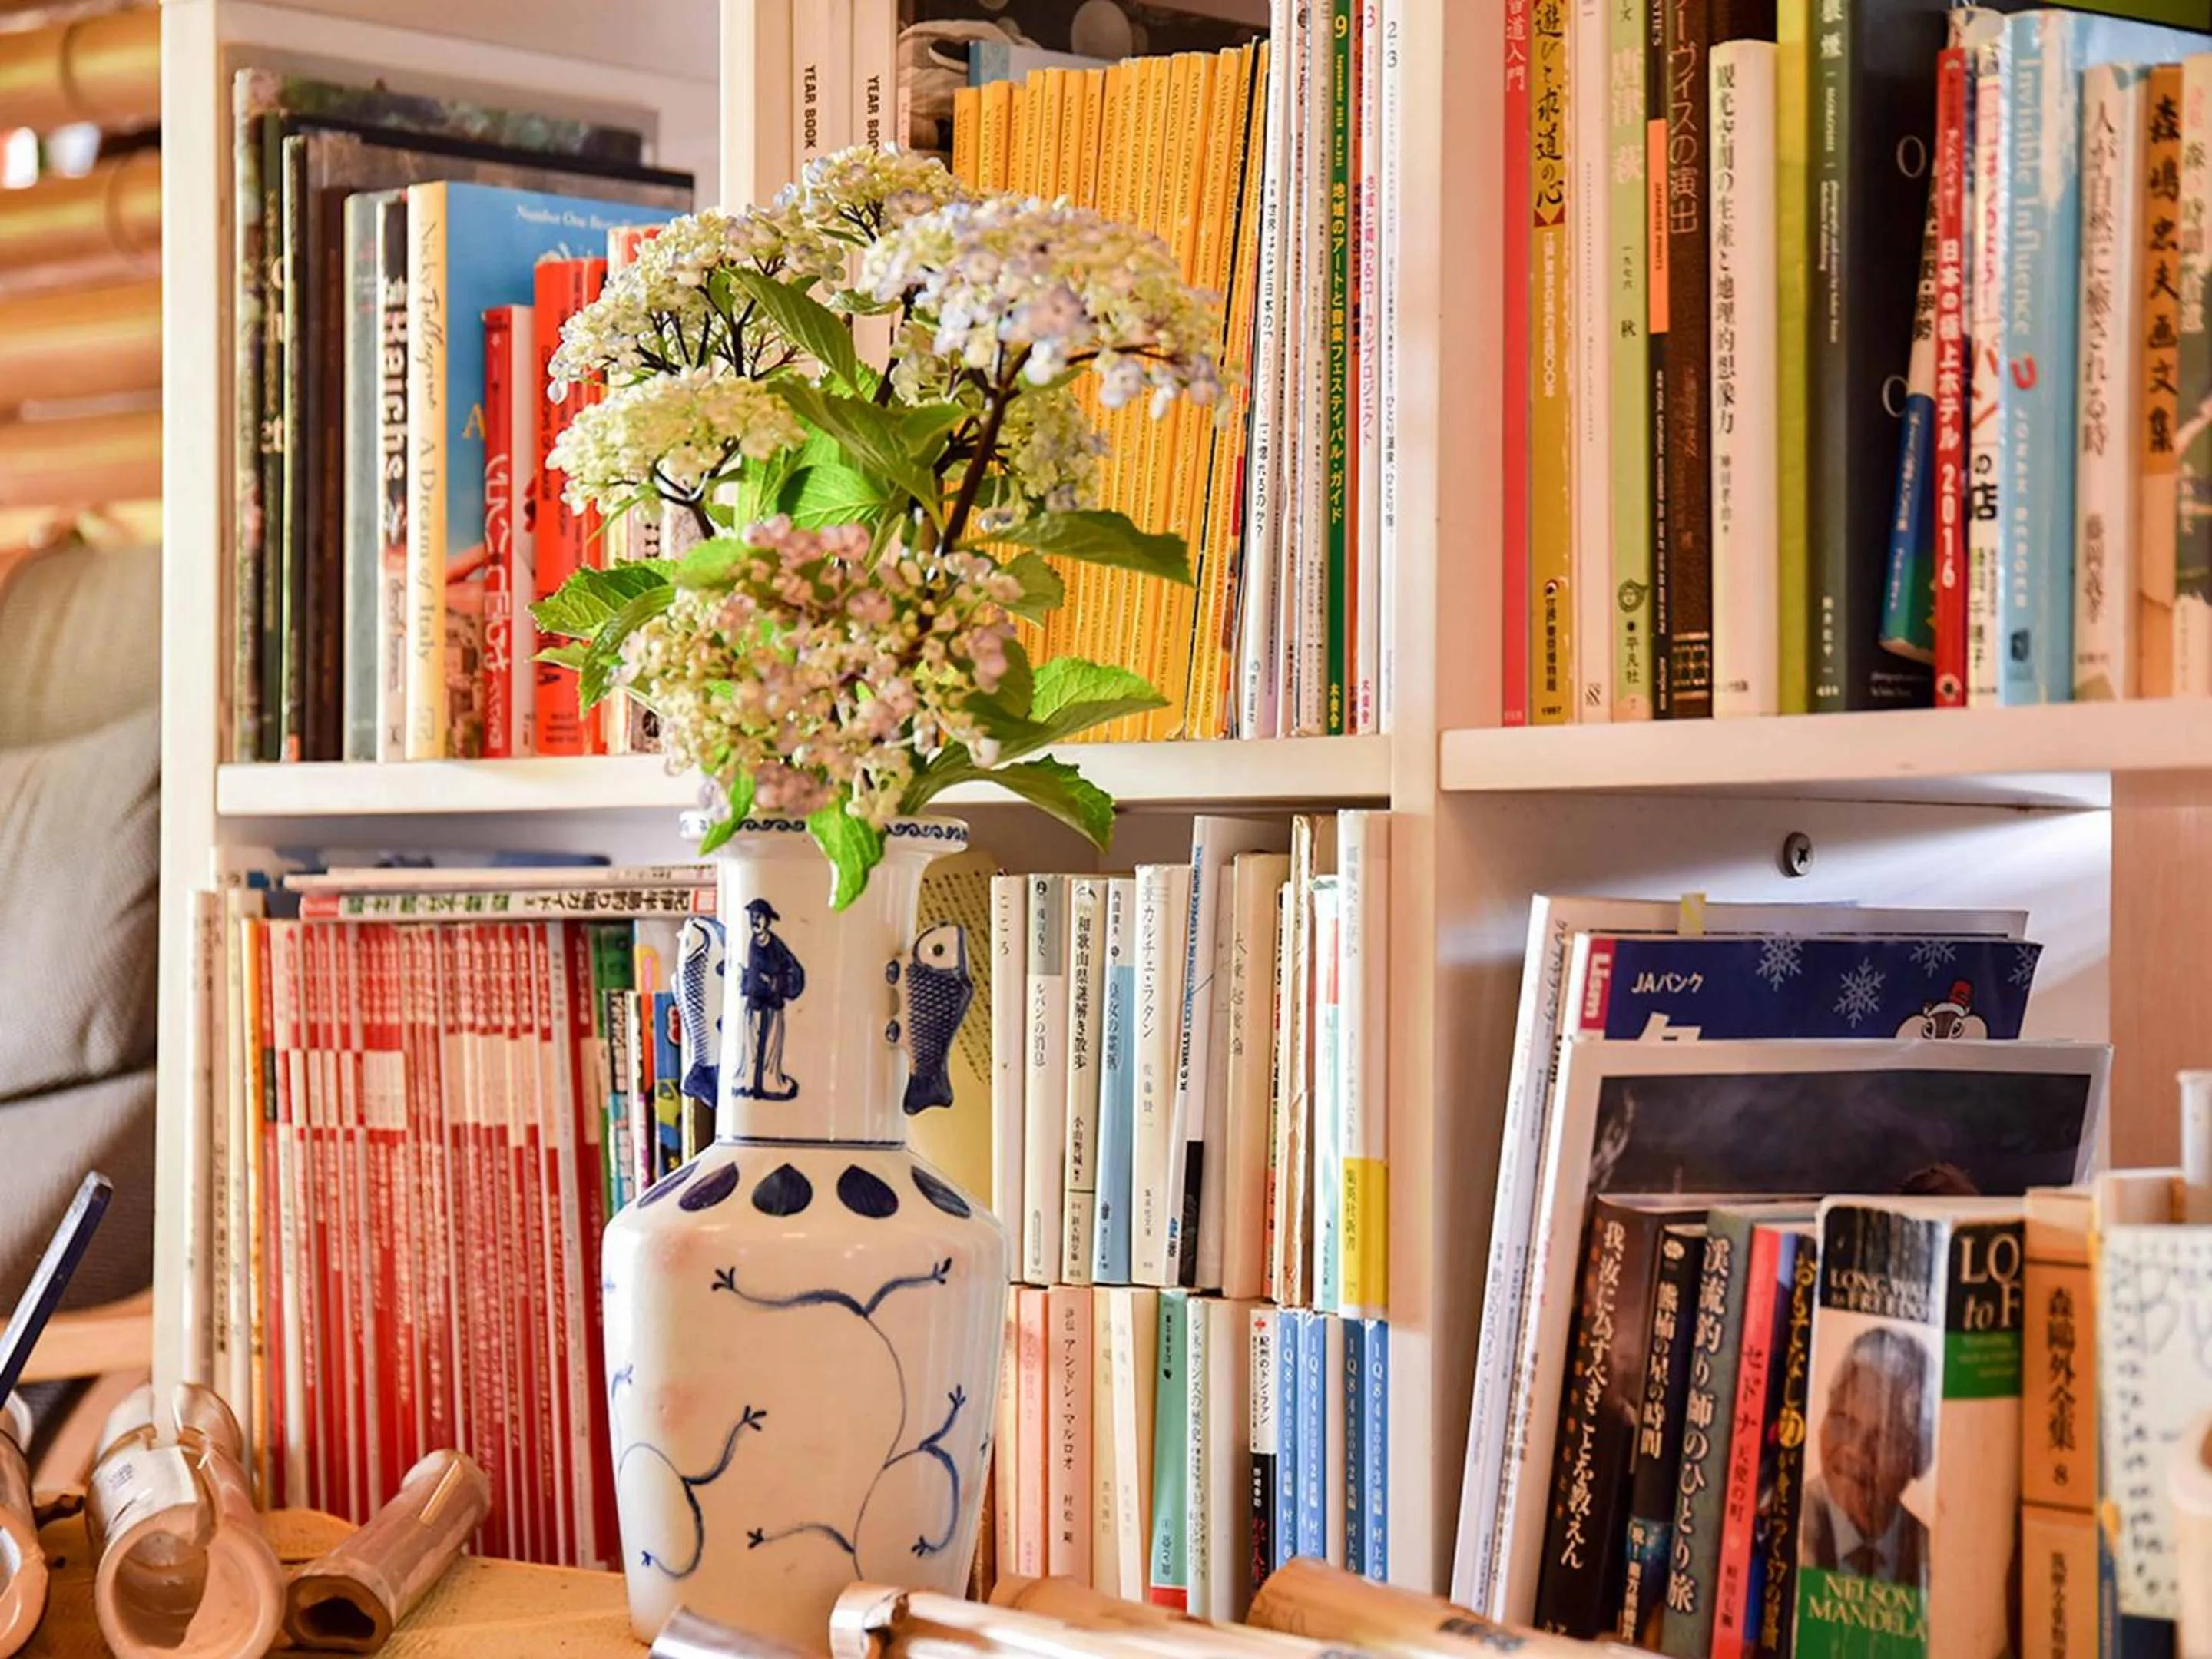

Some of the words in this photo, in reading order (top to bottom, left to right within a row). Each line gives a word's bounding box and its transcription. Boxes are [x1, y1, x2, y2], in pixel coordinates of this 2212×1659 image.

[1335, 15, 1347, 38] 9
[804, 65, 817, 104] YEAR
[867, 75, 879, 115] YEAR
[1189, 72, 1201, 131] NATIONAL
[1217, 74, 1230, 136] NATIONAL
[804, 108, 817, 149] BOOK
[2016, 58, 2042, 184] Invisible
[1654, 182, 1663, 232] JAPANESE
[419, 220, 439, 286] Nicky
[1654, 234, 1664, 270] PRINTS
[2012, 196, 2041, 335] Influence
[419, 438, 436, 458] A
[2014, 407, 2028, 494] JONAH
[419, 469, 436, 558] Dream
[1941, 464, 1956, 588] 2016
[416, 566, 436, 588] of
[2014, 508, 2028, 608] BERGER
[416, 604, 435, 663] Italy
[998, 896, 1010, 957] こころ
[1630, 972, 1704, 994] JAバンク
[1182, 1031, 1191, 1065] WELLS
[1830, 1269, 1885, 1293] LONG
[1963, 1293, 1994, 1330] to
[1283, 1328, 1294, 1402] 1Q84
[1308, 1336, 1320, 1411] 1Q84
[1346, 1338, 1358, 1413] 1Q84
[1372, 1342, 1383, 1417] 1Q84
[1806, 1595, 1927, 1642] MANDELA
[1823, 1572, 1916, 1613] NELSON
